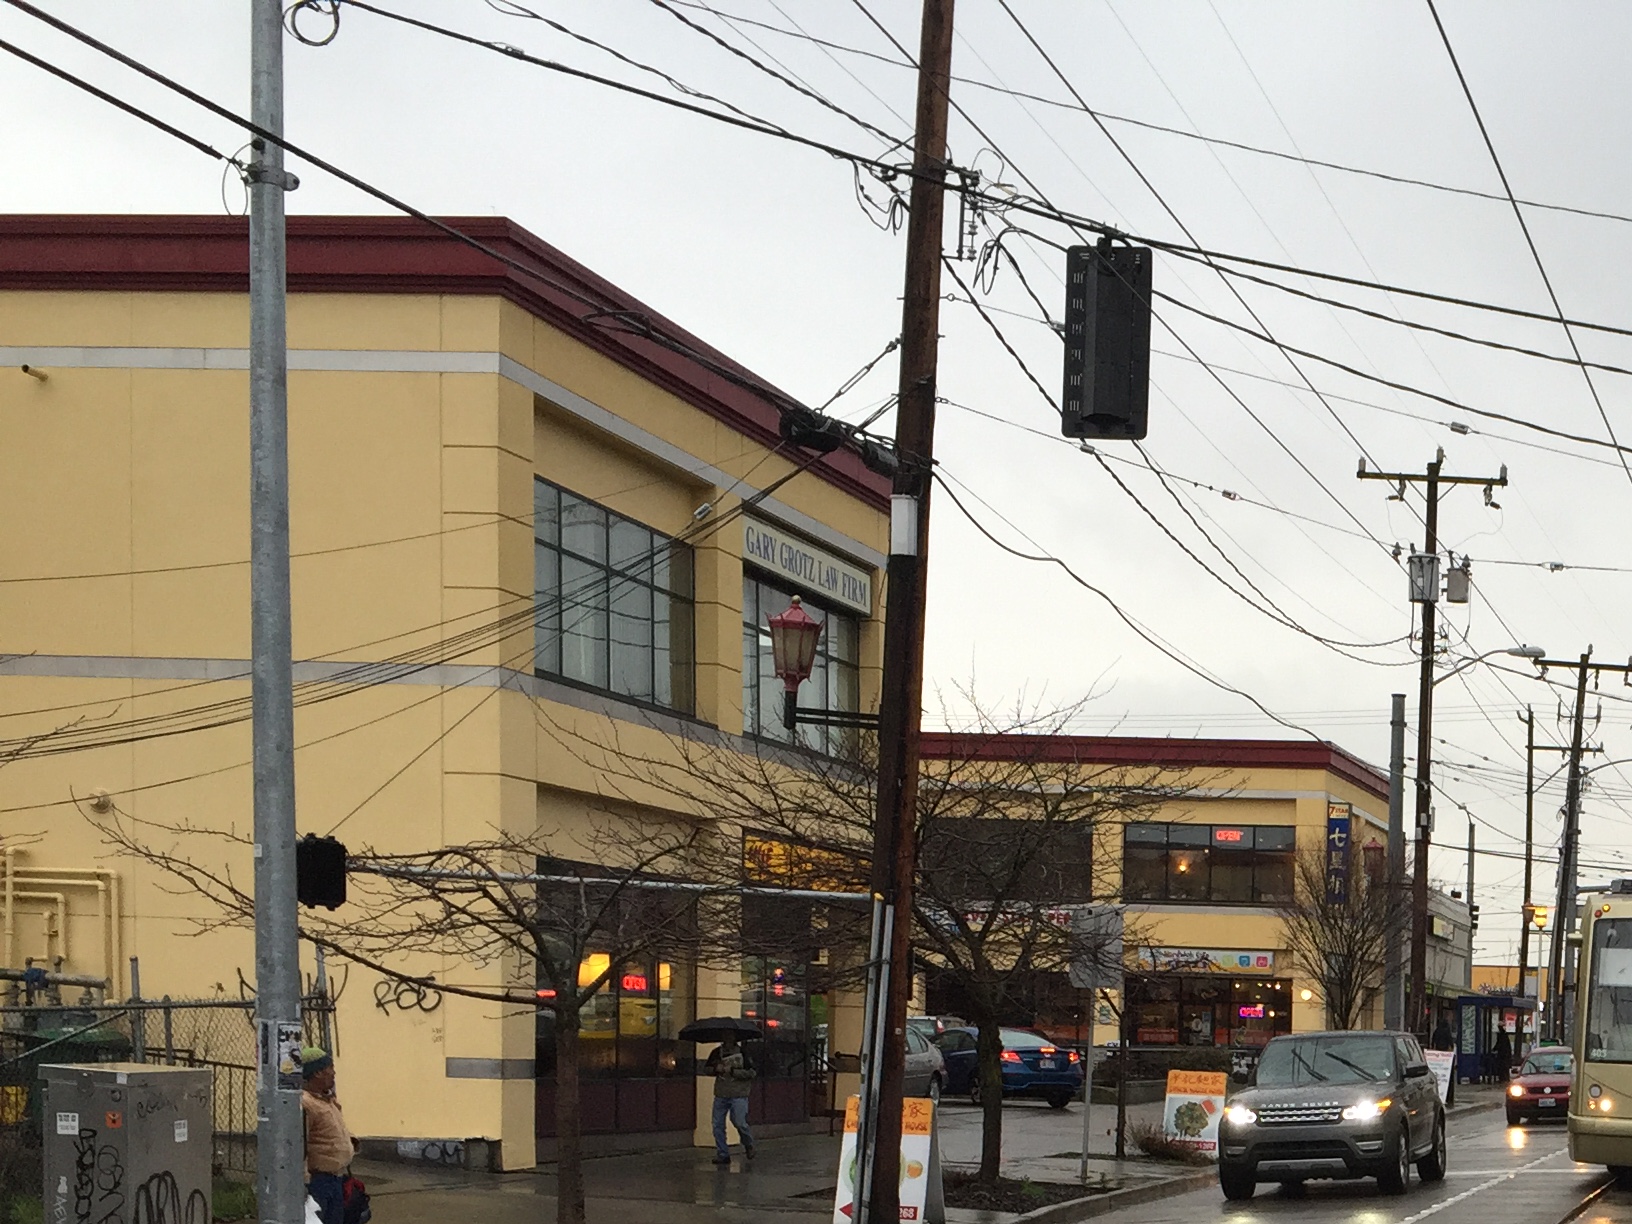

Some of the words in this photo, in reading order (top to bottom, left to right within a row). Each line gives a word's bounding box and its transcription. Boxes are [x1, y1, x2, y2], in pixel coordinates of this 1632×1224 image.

[745, 526, 777, 564] GARY
[780, 542, 816, 583] GROTZ
[817, 560, 839, 593] LAW
[842, 572, 867, 607] FIRM
